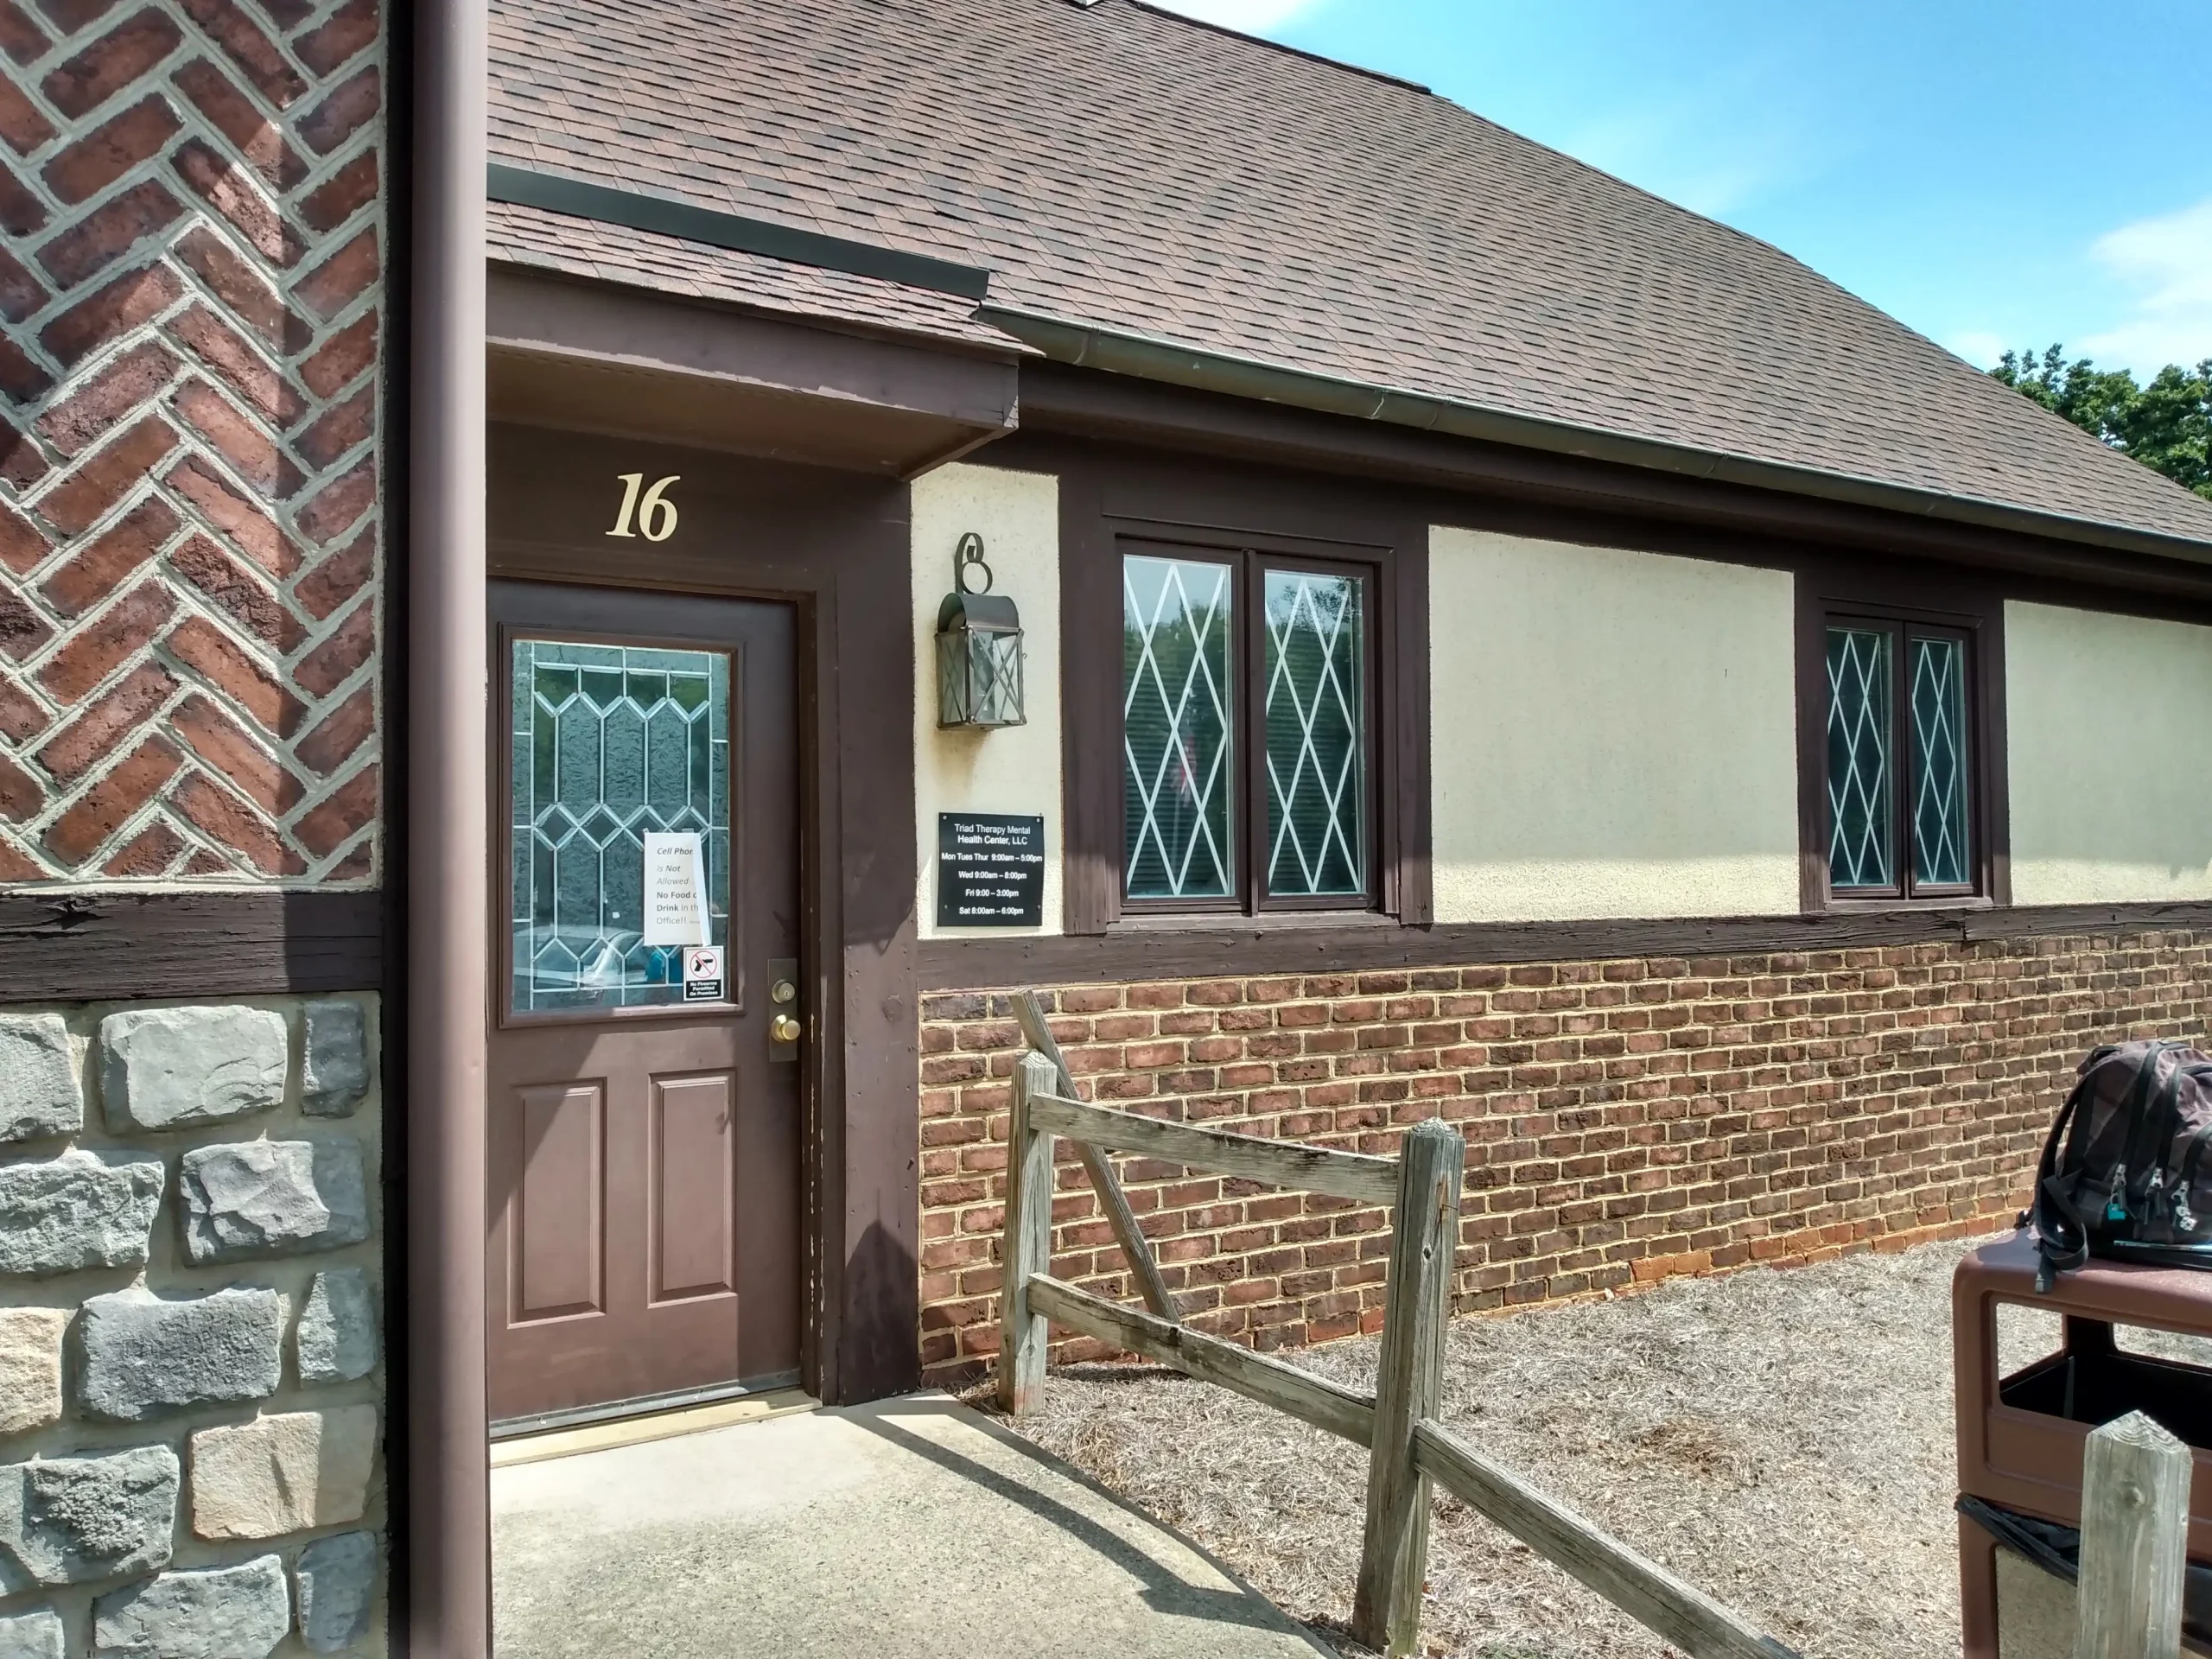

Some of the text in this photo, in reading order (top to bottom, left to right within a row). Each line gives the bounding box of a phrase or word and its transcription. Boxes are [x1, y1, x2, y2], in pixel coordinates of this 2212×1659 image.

[606, 473, 681, 542] 16
[954, 823, 1031, 835] Triad Therapy Mental
[984, 836, 1010, 845] Center,
[1013, 836, 1027, 845] LLC
[1020, 855, 1043, 863] 5:00pm
[1005, 872, 1027, 880] 8:00pm
[1001, 907, 1024, 916] 6:00pm
